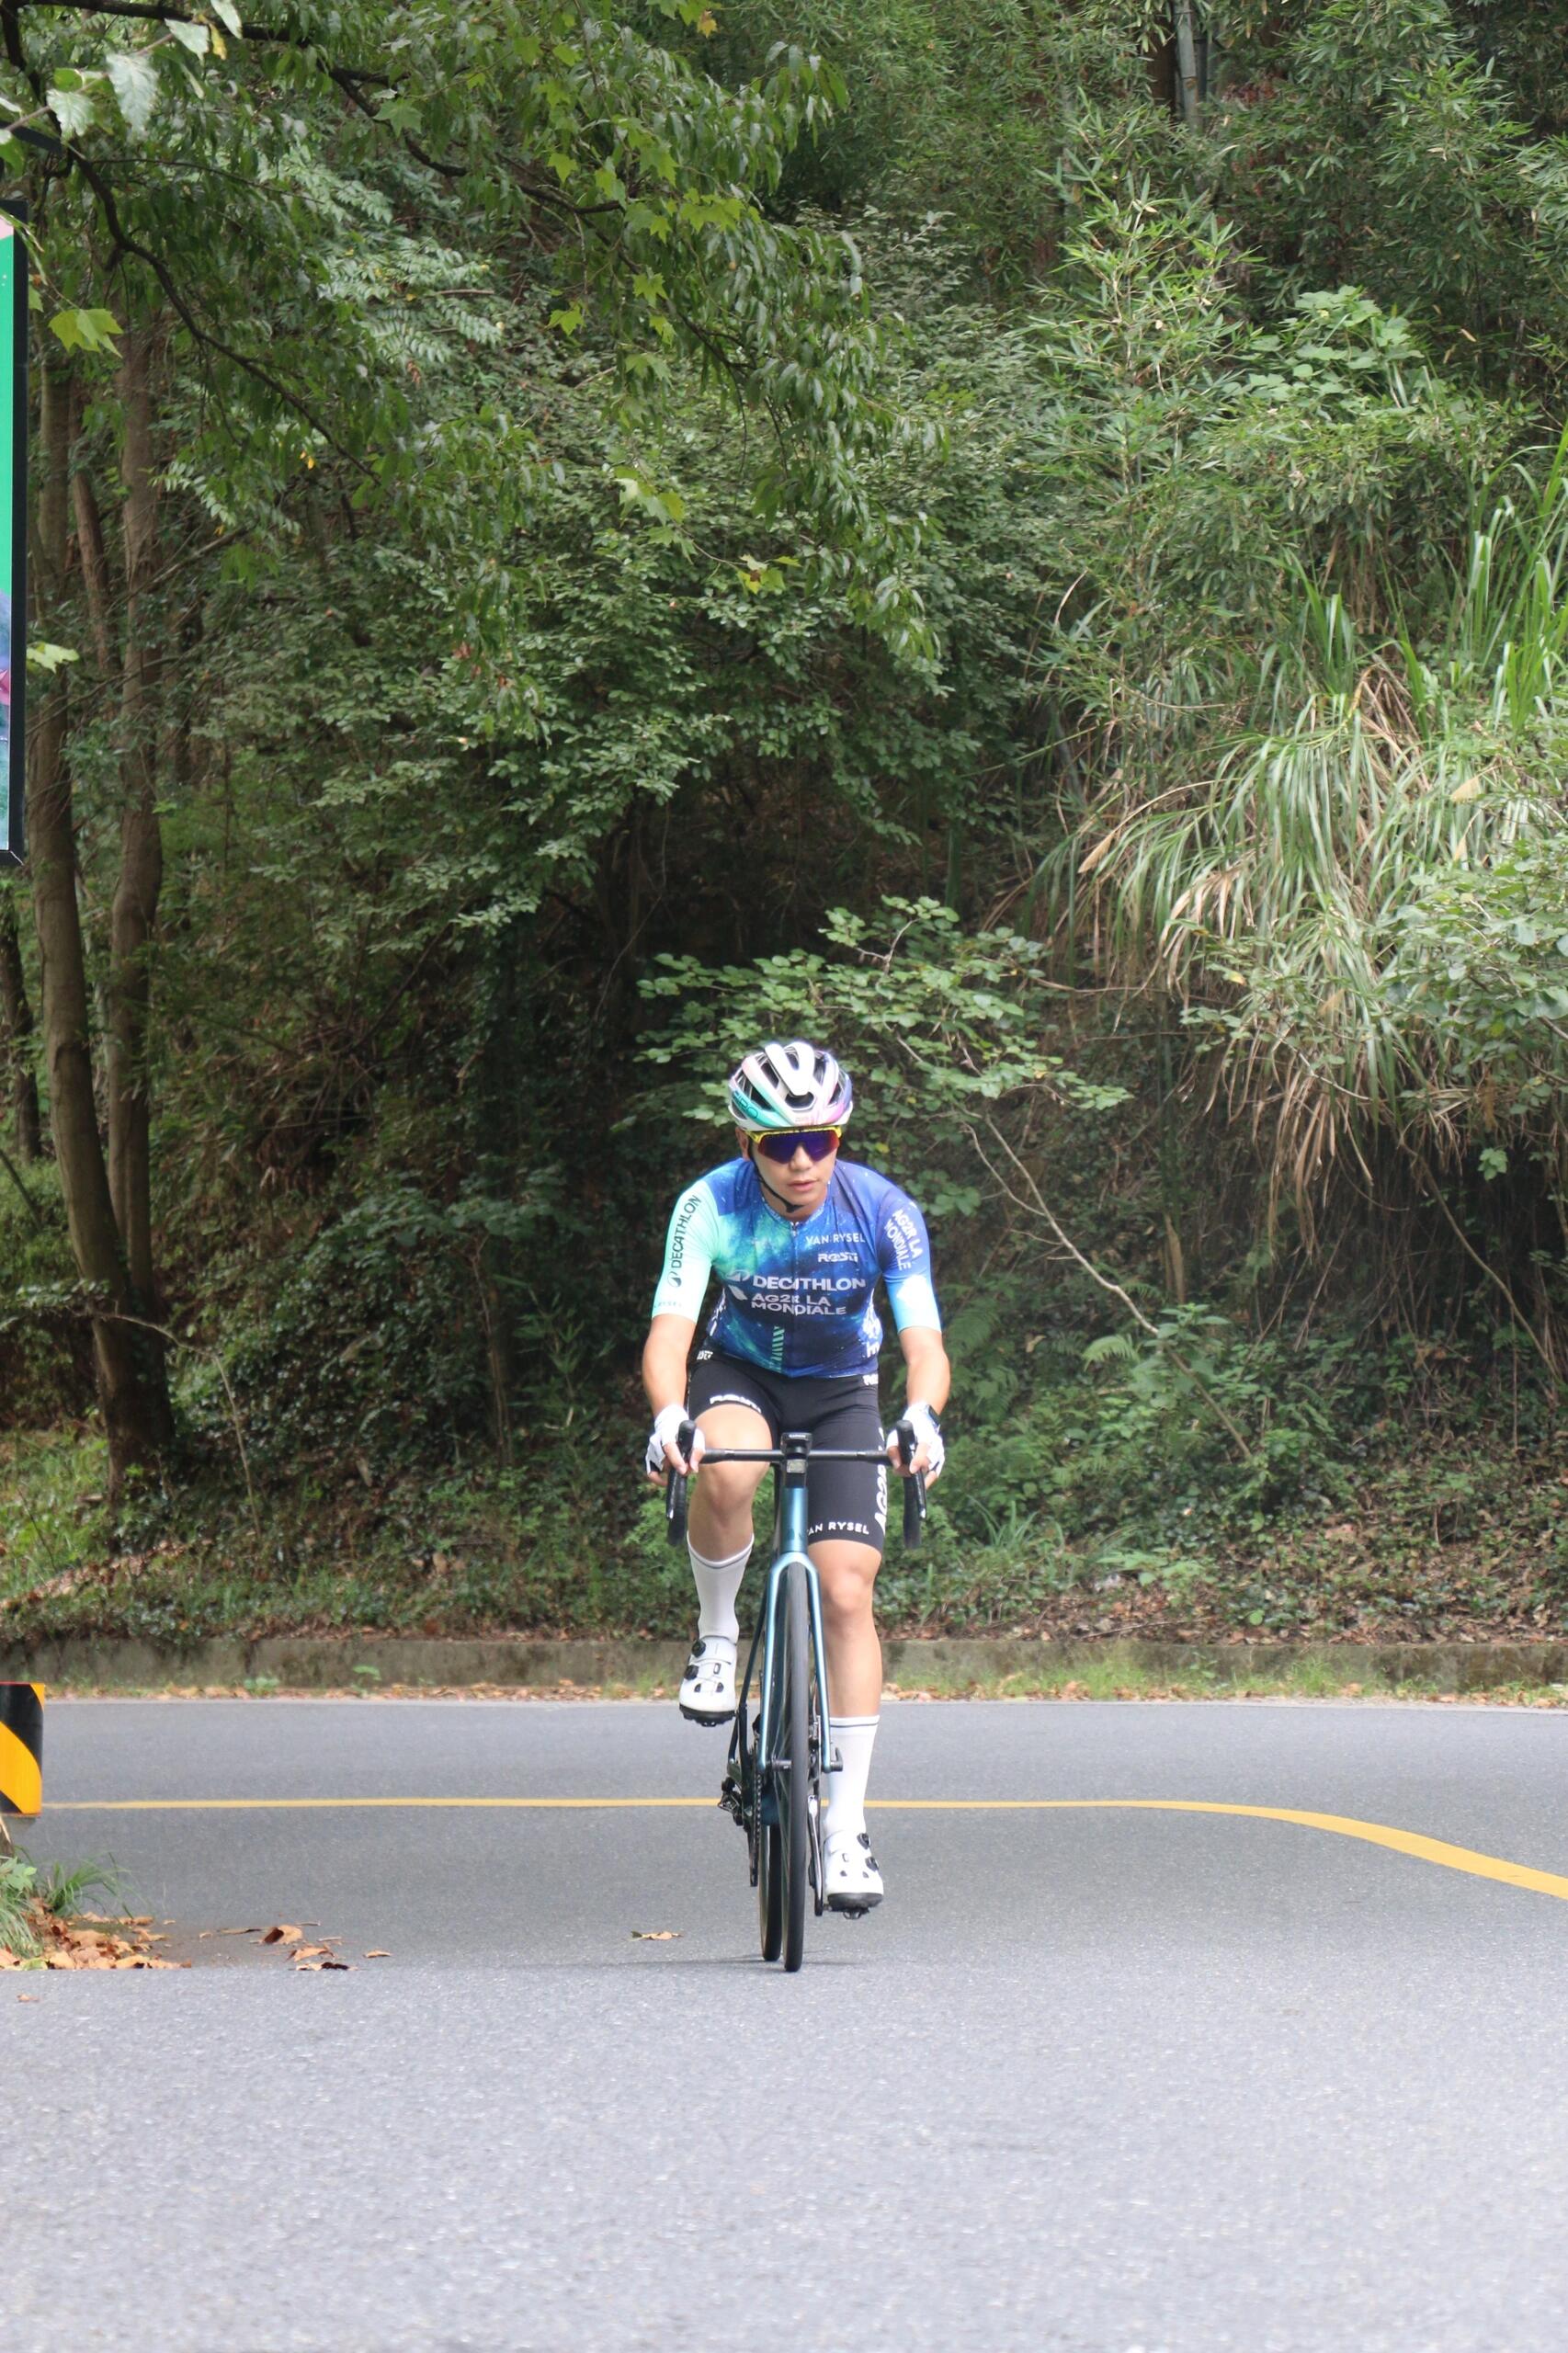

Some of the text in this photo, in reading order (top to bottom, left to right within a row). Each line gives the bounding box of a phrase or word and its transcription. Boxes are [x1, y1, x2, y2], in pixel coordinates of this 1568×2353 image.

[671, 1195, 701, 1268] DECATHLON
[805, 1233, 866, 1245] VAN RYSEL
[884, 1219, 912, 1271] MONDIALE
[753, 1275, 866, 1291] DECATHLON
[752, 1292, 831, 1307] AG2R LA
[751, 1301, 846, 1316] MONDIALE
[807, 1521, 869, 1536] AN RYSEL
